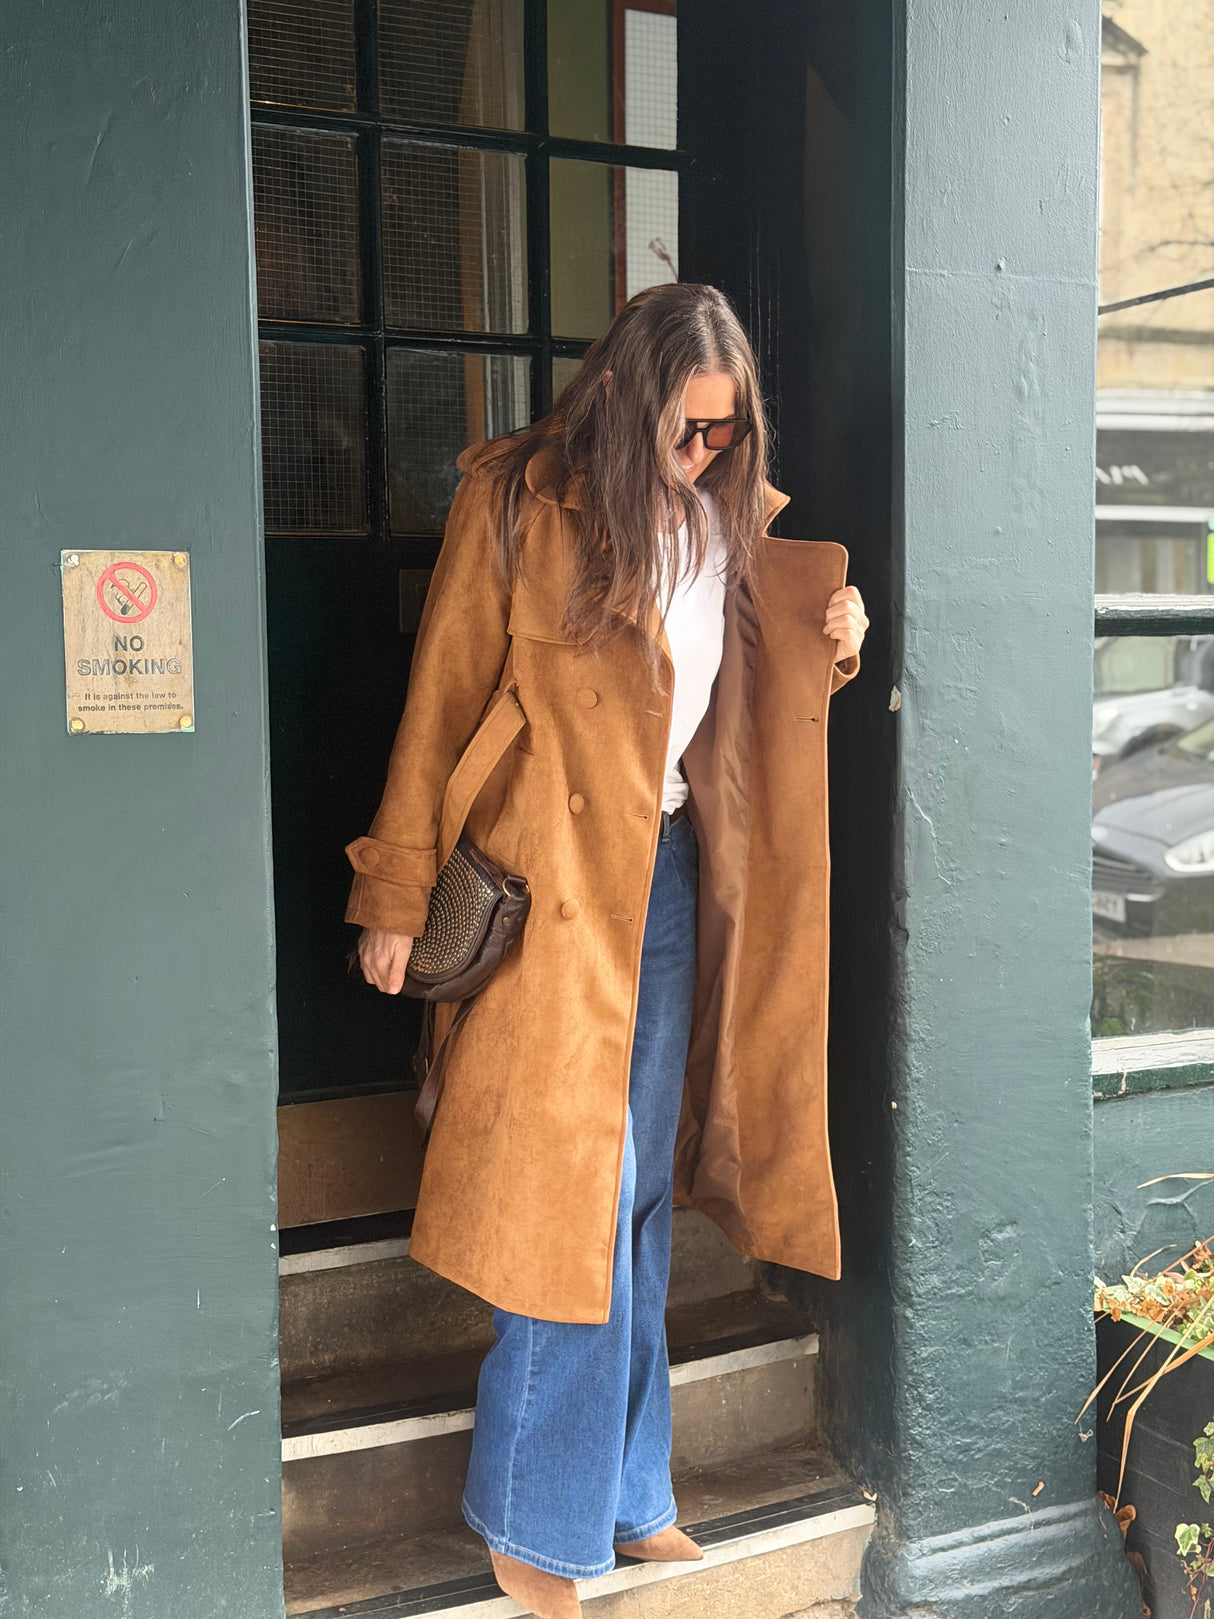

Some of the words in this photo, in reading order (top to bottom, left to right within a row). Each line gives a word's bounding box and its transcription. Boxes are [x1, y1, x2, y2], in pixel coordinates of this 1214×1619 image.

[114, 635, 145, 652] NO
[77, 657, 181, 676] SMOKING
[84, 692, 91, 701] It
[93, 692, 101, 701] is
[102, 692, 134, 702] against
[136, 692, 150, 700] the
[151, 691, 166, 700] law
[168, 691, 177, 699] to
[78, 704, 106, 712] smoke
[108, 703, 116, 711] in
[118, 703, 142, 711] these
[143, 702, 184, 712] premises.
